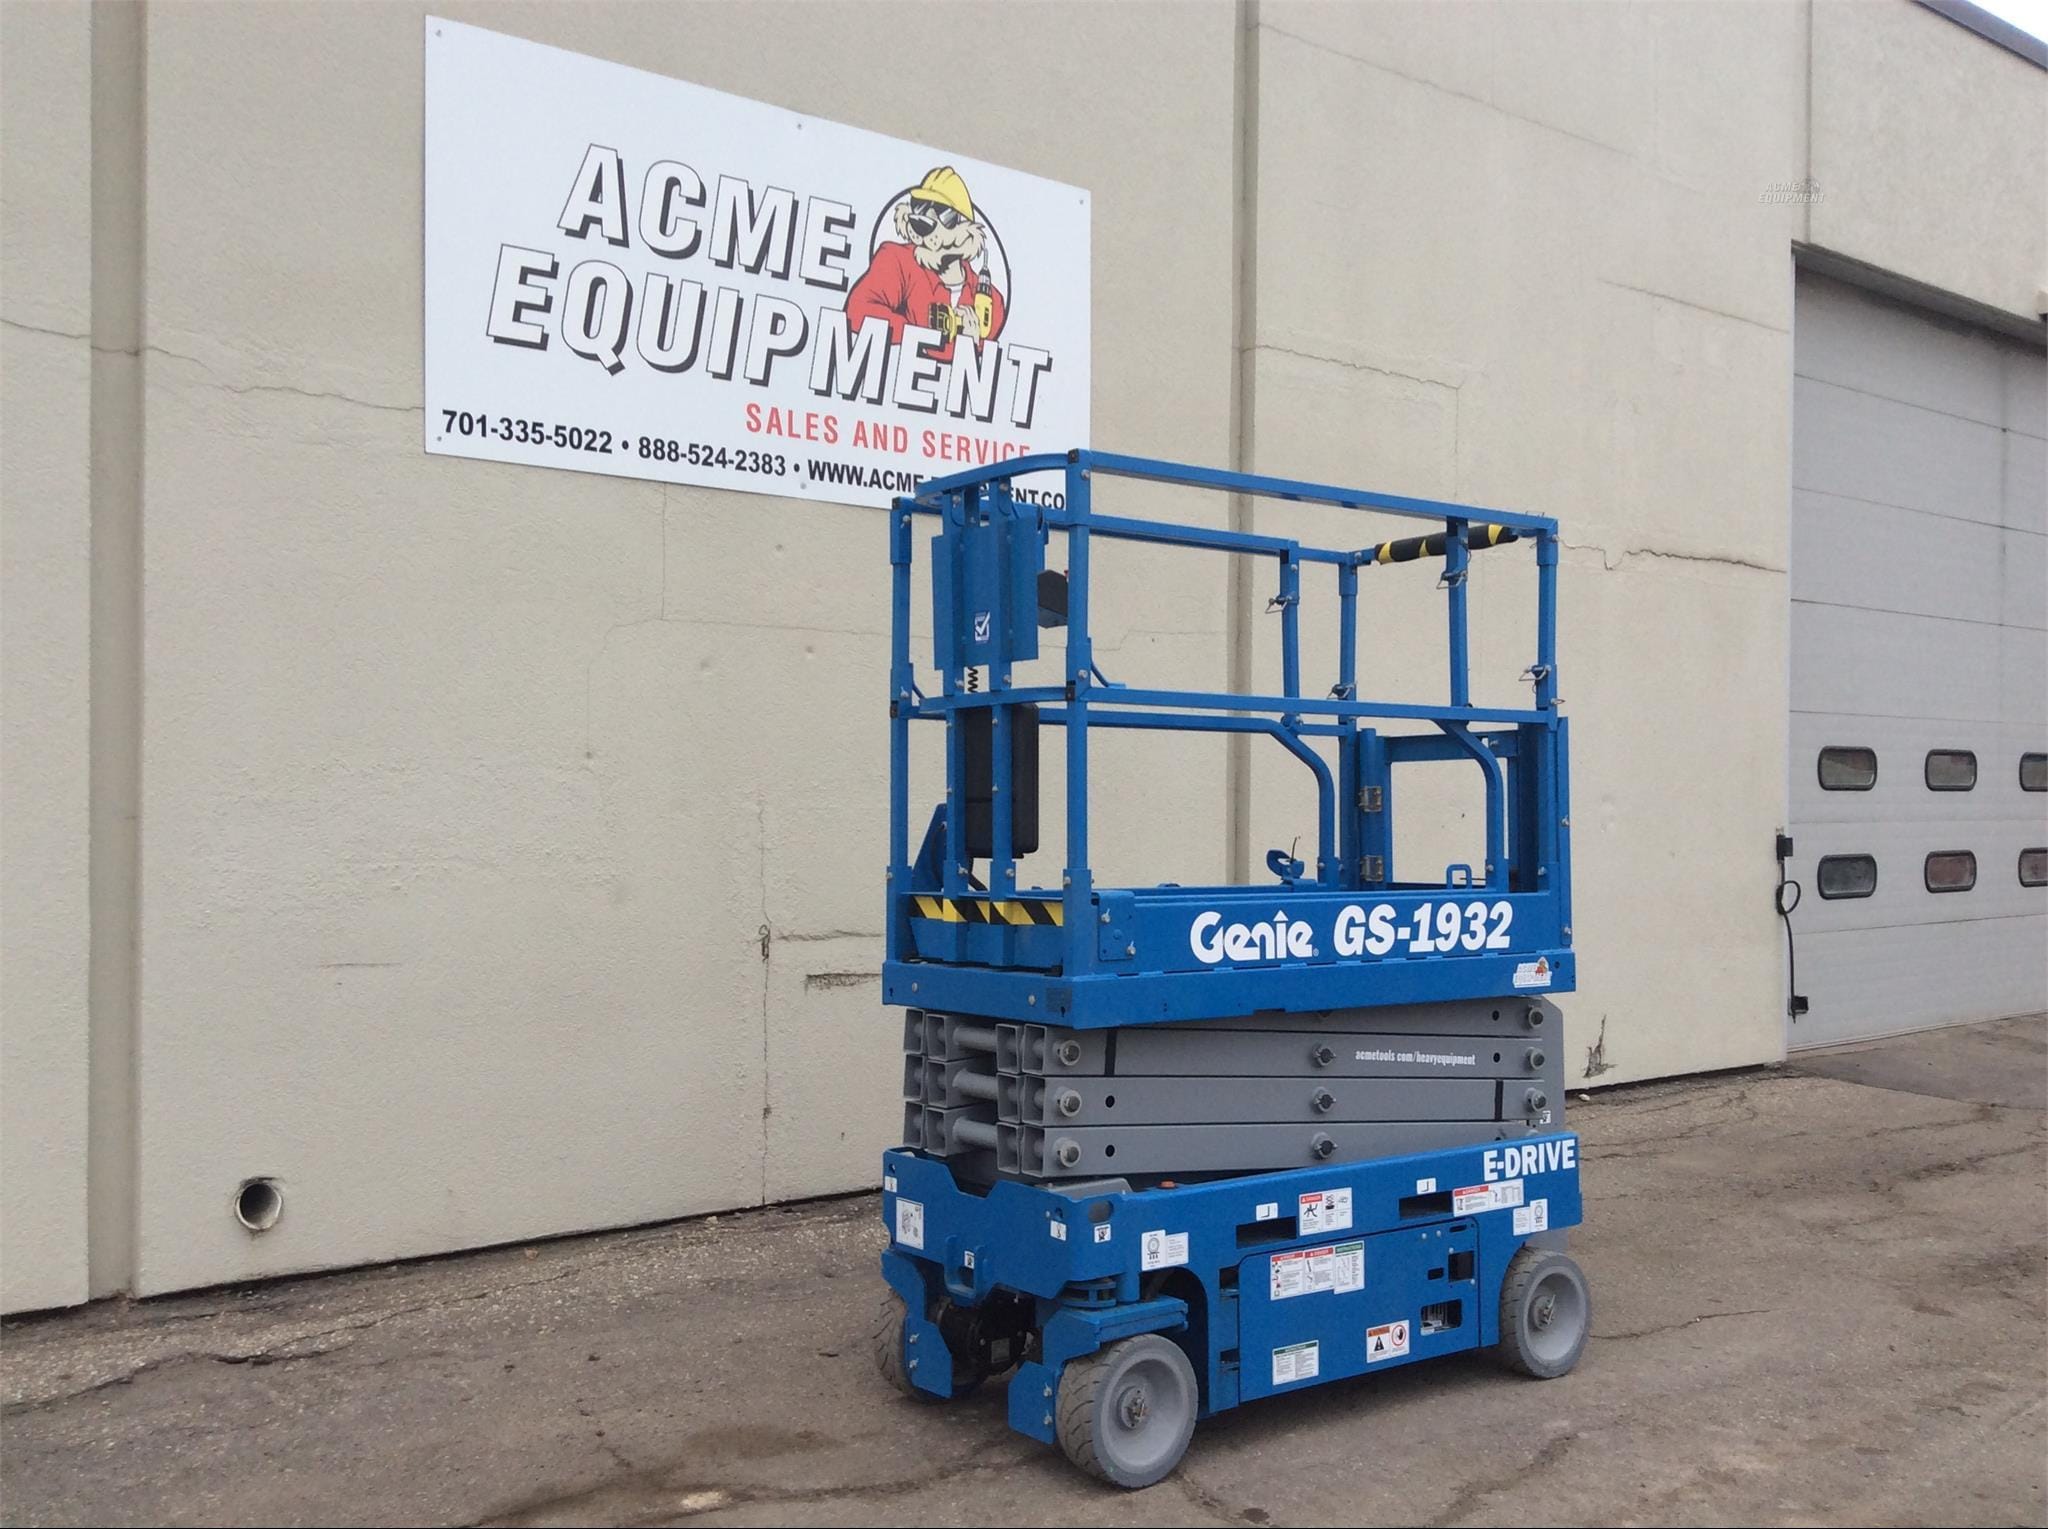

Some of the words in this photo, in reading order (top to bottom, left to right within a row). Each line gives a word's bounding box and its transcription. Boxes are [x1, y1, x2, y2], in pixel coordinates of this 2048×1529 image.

[557, 143, 856, 292] ACME
[486, 243, 1053, 429] EQUIPMENT
[442, 409, 613, 454] 701-335-5022
[638, 436, 786, 476] 888-524-2383
[745, 402, 840, 444] SALES
[852, 420, 909, 454] AND
[1190, 909, 1314, 964] Genie
[1333, 900, 1514, 958] GS-1932
[1354, 1048, 1477, 1067] acmetoolscom/heavyequipment
[1483, 1138, 1577, 1182] E-DRIVE
